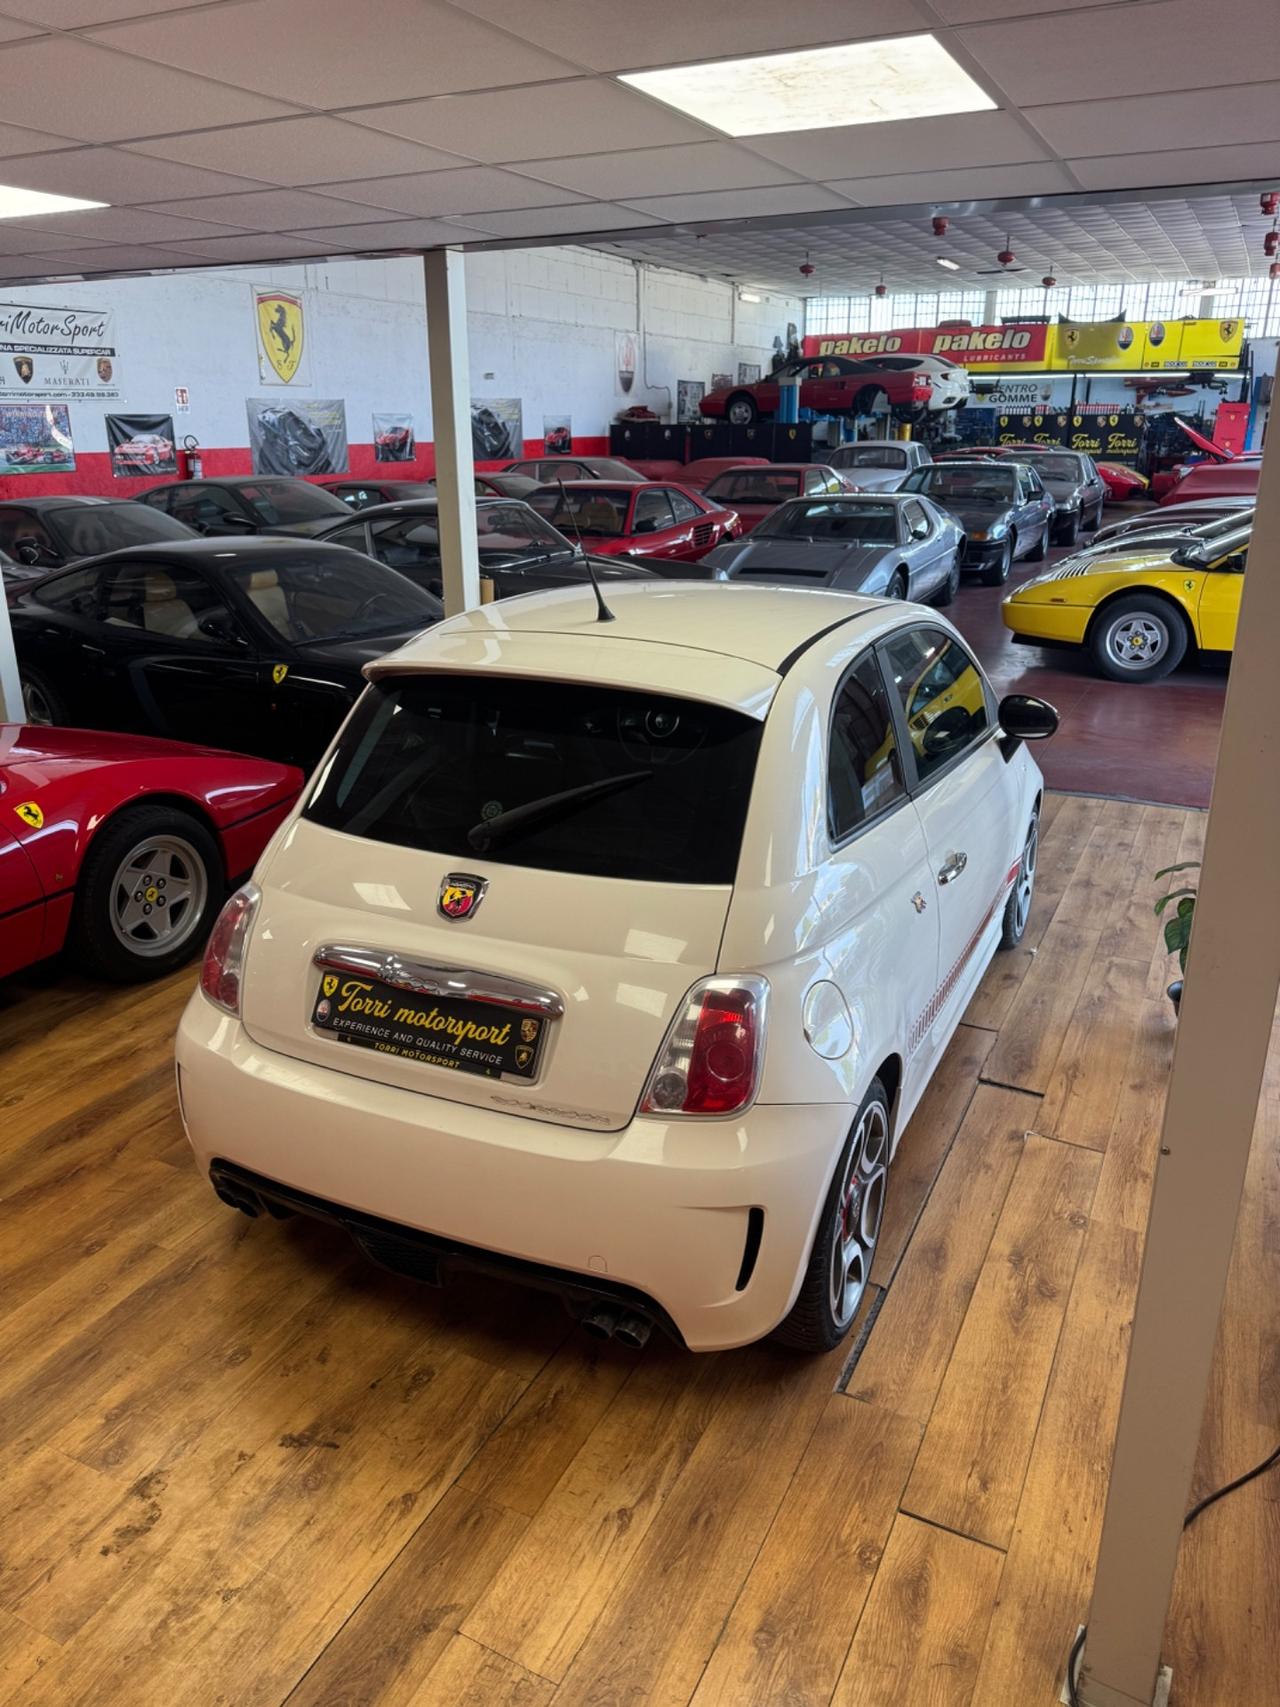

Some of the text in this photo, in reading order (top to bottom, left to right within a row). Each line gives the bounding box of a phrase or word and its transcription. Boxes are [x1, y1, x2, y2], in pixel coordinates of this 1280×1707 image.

[14, 345, 72, 354] SPECIALIZZATA
[819, 335, 902, 355] pakelo
[932, 329, 1032, 354] pakelo
[963, 354, 1026, 362] LUBRICANTS
[44, 377, 90, 386] MASERATI
[999, 383, 1038, 393] ENTRO
[989, 393, 1038, 403] GOMME
[1071, 433, 1101, 449] Torri
[1108, 432, 1137, 449] Torri
[338, 980, 392, 1019] Torri
[394, 1007, 512, 1046] motorsport
[332, 1017, 504, 1065] EXPERIENCE AND QUALITY SERVICE
[374, 1042, 460, 1069] TORRI MOTORSPORT
